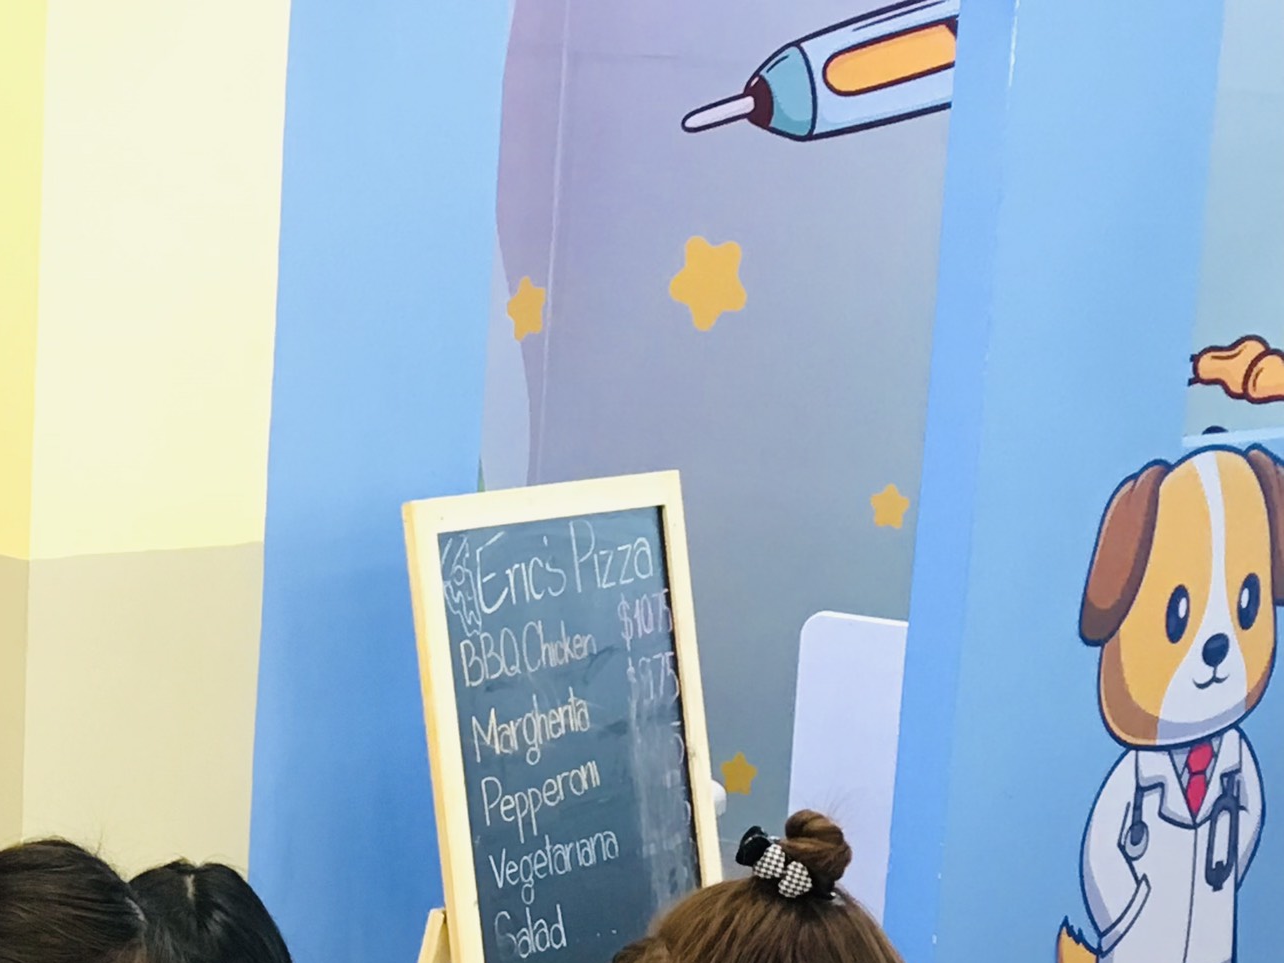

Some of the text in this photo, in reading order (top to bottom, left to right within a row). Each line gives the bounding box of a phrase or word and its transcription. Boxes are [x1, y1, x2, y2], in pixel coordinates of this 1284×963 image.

[476, 519, 654, 615] Eric's Pizza
[460, 620, 597, 687] BBQ Chicken
[472, 686, 591, 765] Margherita
[481, 760, 601, 844] Pepperoni
[488, 830, 620, 905] Vegetariana
[494, 904, 567, 958] Salad
